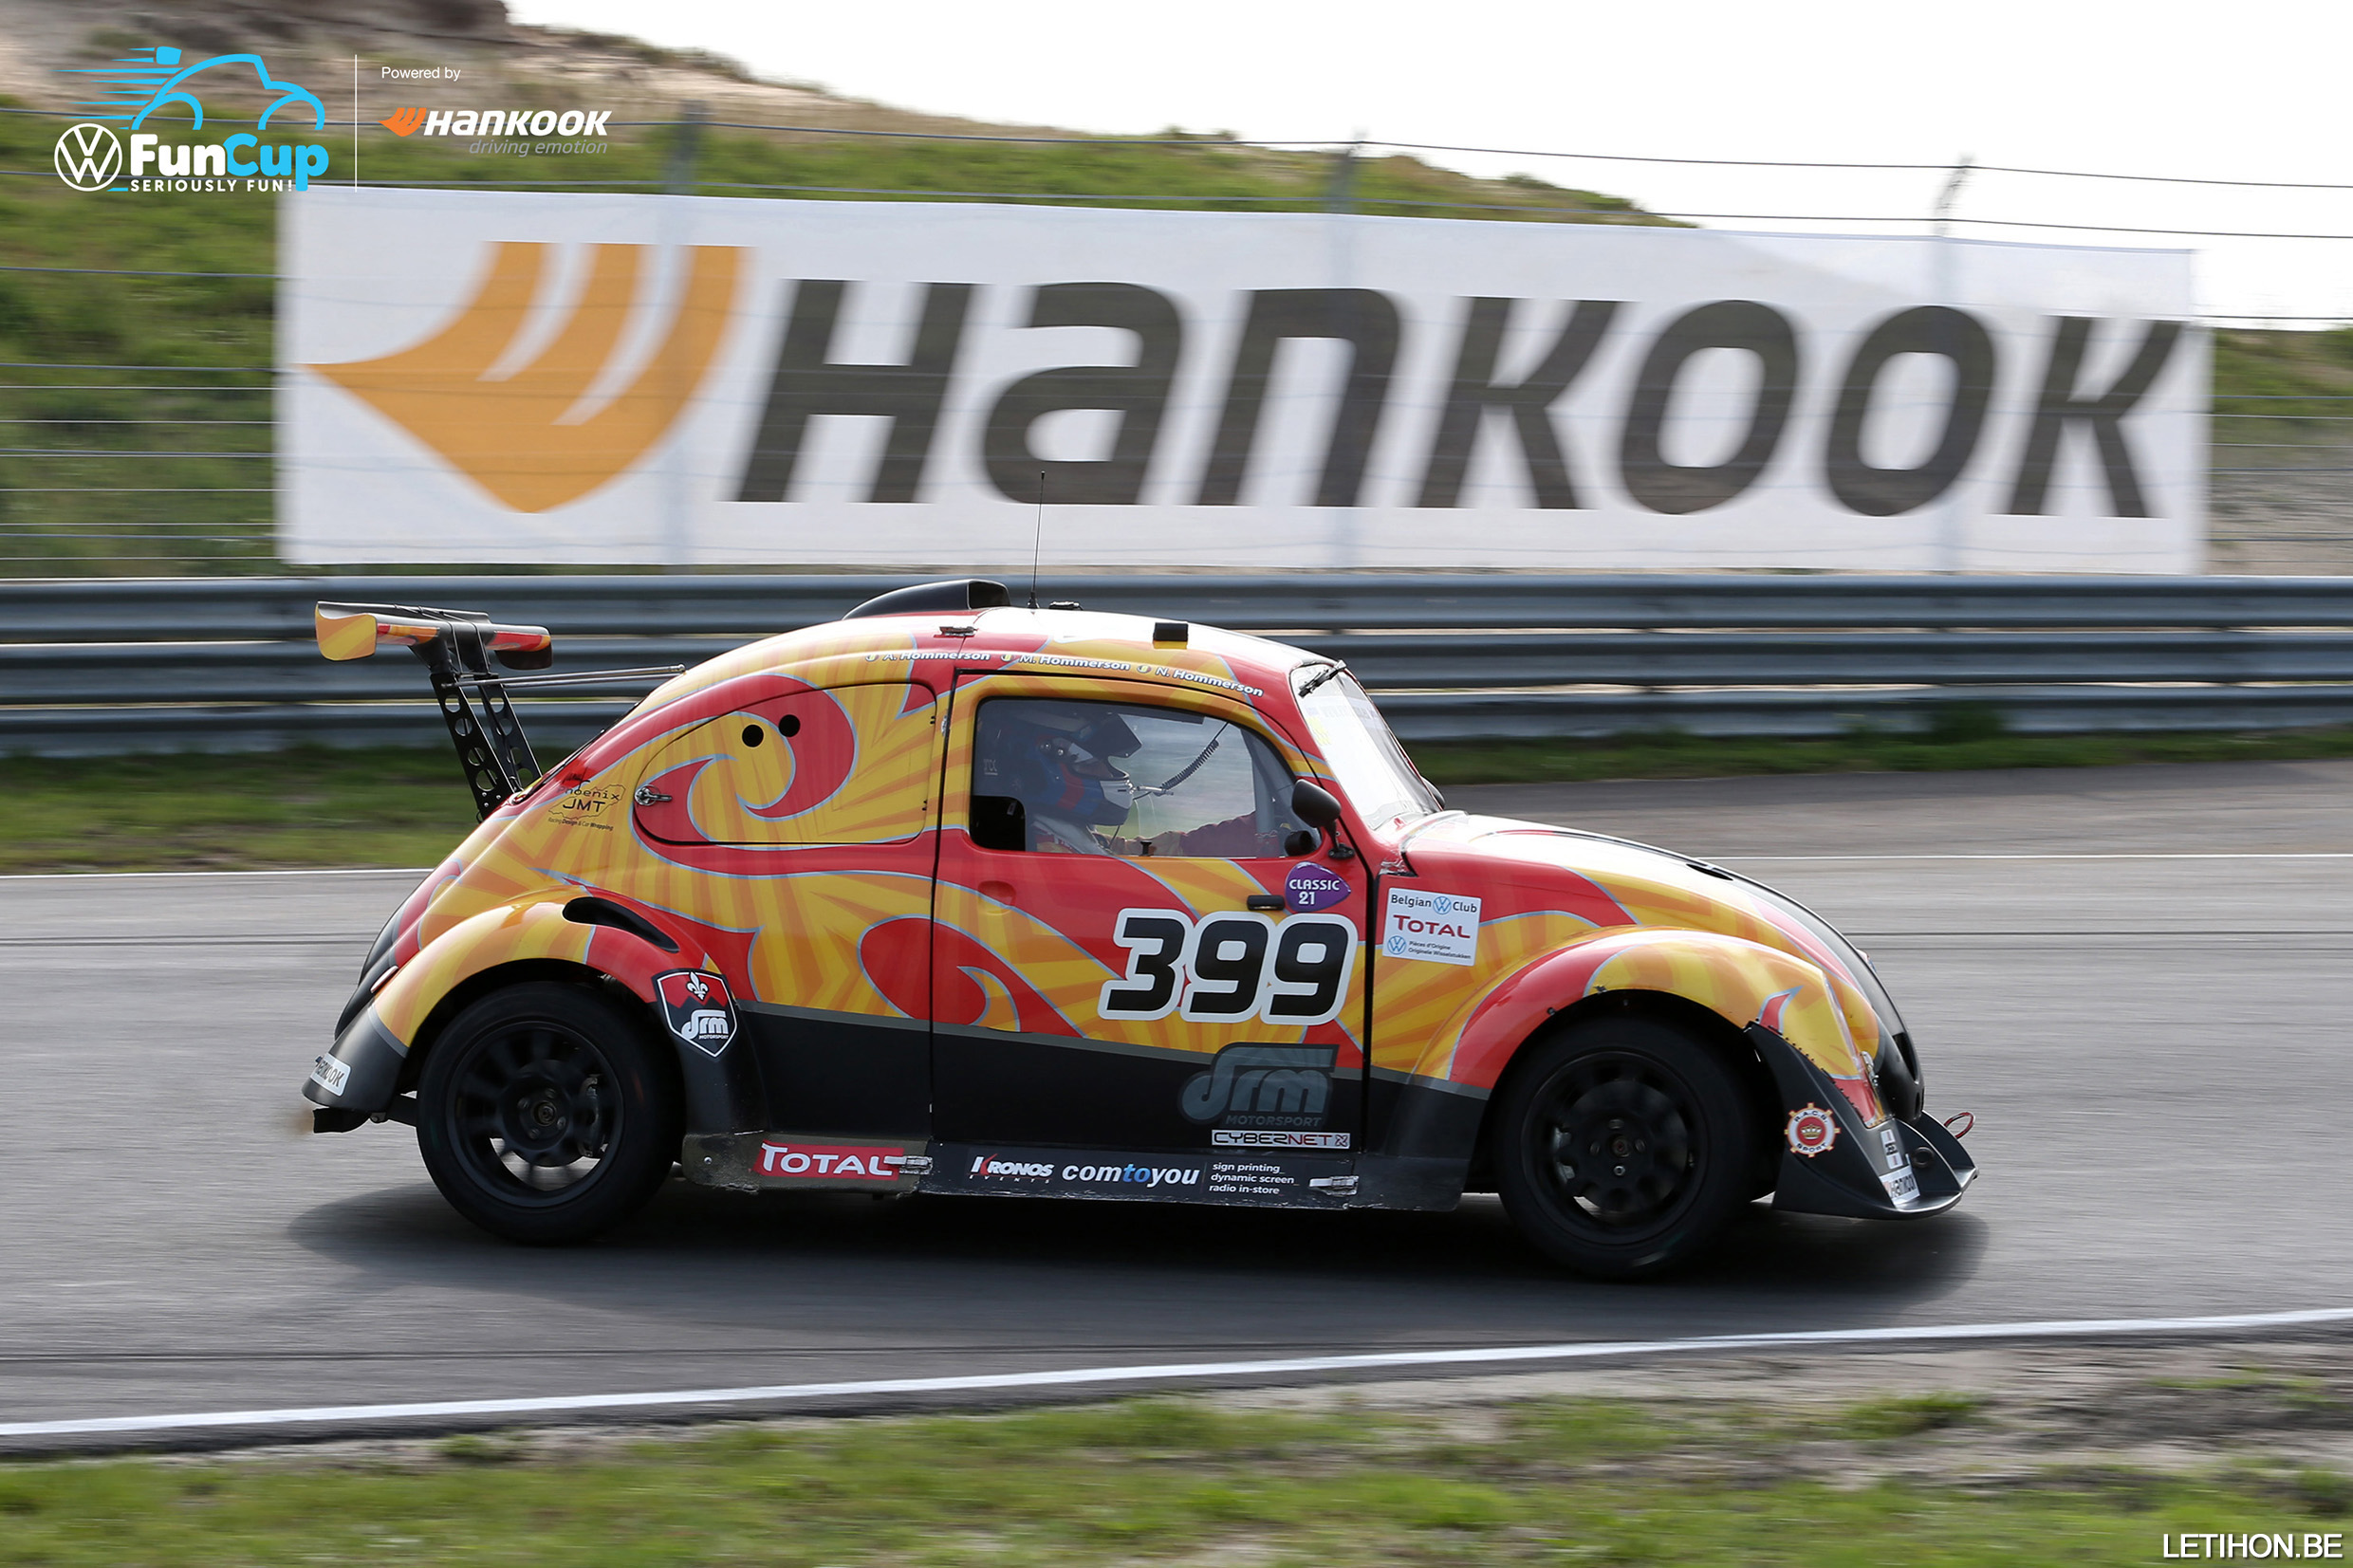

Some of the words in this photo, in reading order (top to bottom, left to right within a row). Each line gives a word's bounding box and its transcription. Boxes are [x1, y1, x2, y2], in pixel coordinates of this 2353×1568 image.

[899, 652, 991, 661] Hommerson
[1019, 655, 1036, 664] M.
[1039, 656, 1130, 671] Hommerson
[1156, 667, 1170, 677] N.
[1173, 670, 1264, 697] Hommerson
[563, 799, 605, 812] JMT
[1288, 878, 1340, 891] CLASSIC
[1298, 891, 1315, 905] 21
[1391, 895, 1431, 908] Belgian
[1453, 901, 1477, 913] Club
[1393, 914, 1471, 939] TOTAL
[1101, 911, 1356, 1023] 399
[1226, 1115, 1322, 1127] MOTORSPORT
[1797, 1142, 1826, 1152] SPORT
[761, 1142, 893, 1176] TOTAL
[971, 1153, 1055, 1178] KRONOS
[1213, 1162, 1234, 1172] sign
[969, 1174, 1050, 1184] EVENTS
[1062, 1163, 1201, 1188] comtoyou
[1211, 1173, 1257, 1184] dynamic
[1209, 1184, 1236, 1192] radio
